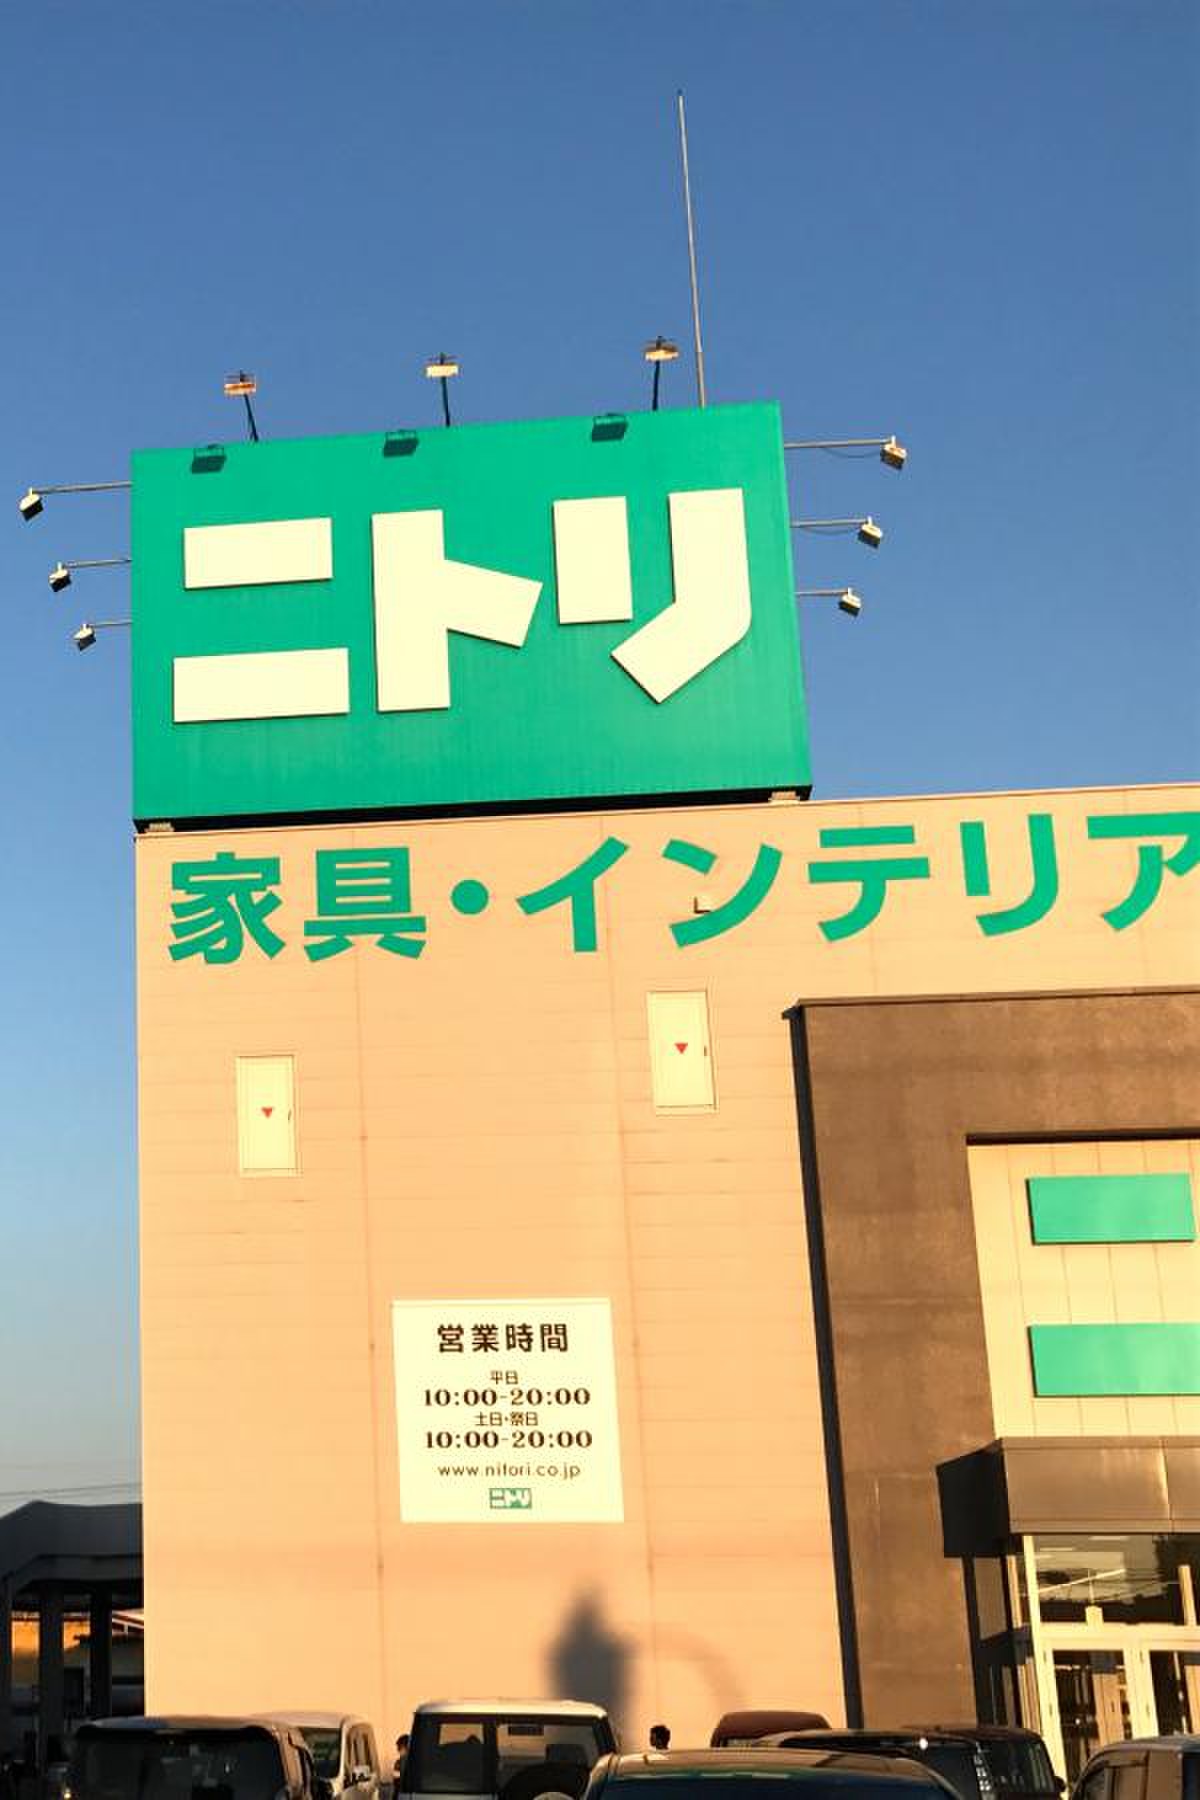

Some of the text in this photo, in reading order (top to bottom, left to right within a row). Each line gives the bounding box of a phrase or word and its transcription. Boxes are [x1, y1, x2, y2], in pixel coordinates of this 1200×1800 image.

[173, 488, 753, 723] ニトリ
[168, 812, 1200, 965] 家具・インテリア
[437, 1323, 568, 1353] 営業時間
[490, 1370, 519, 1385] 平日
[437, 1462, 581, 1480] www.nitori.co.jp
